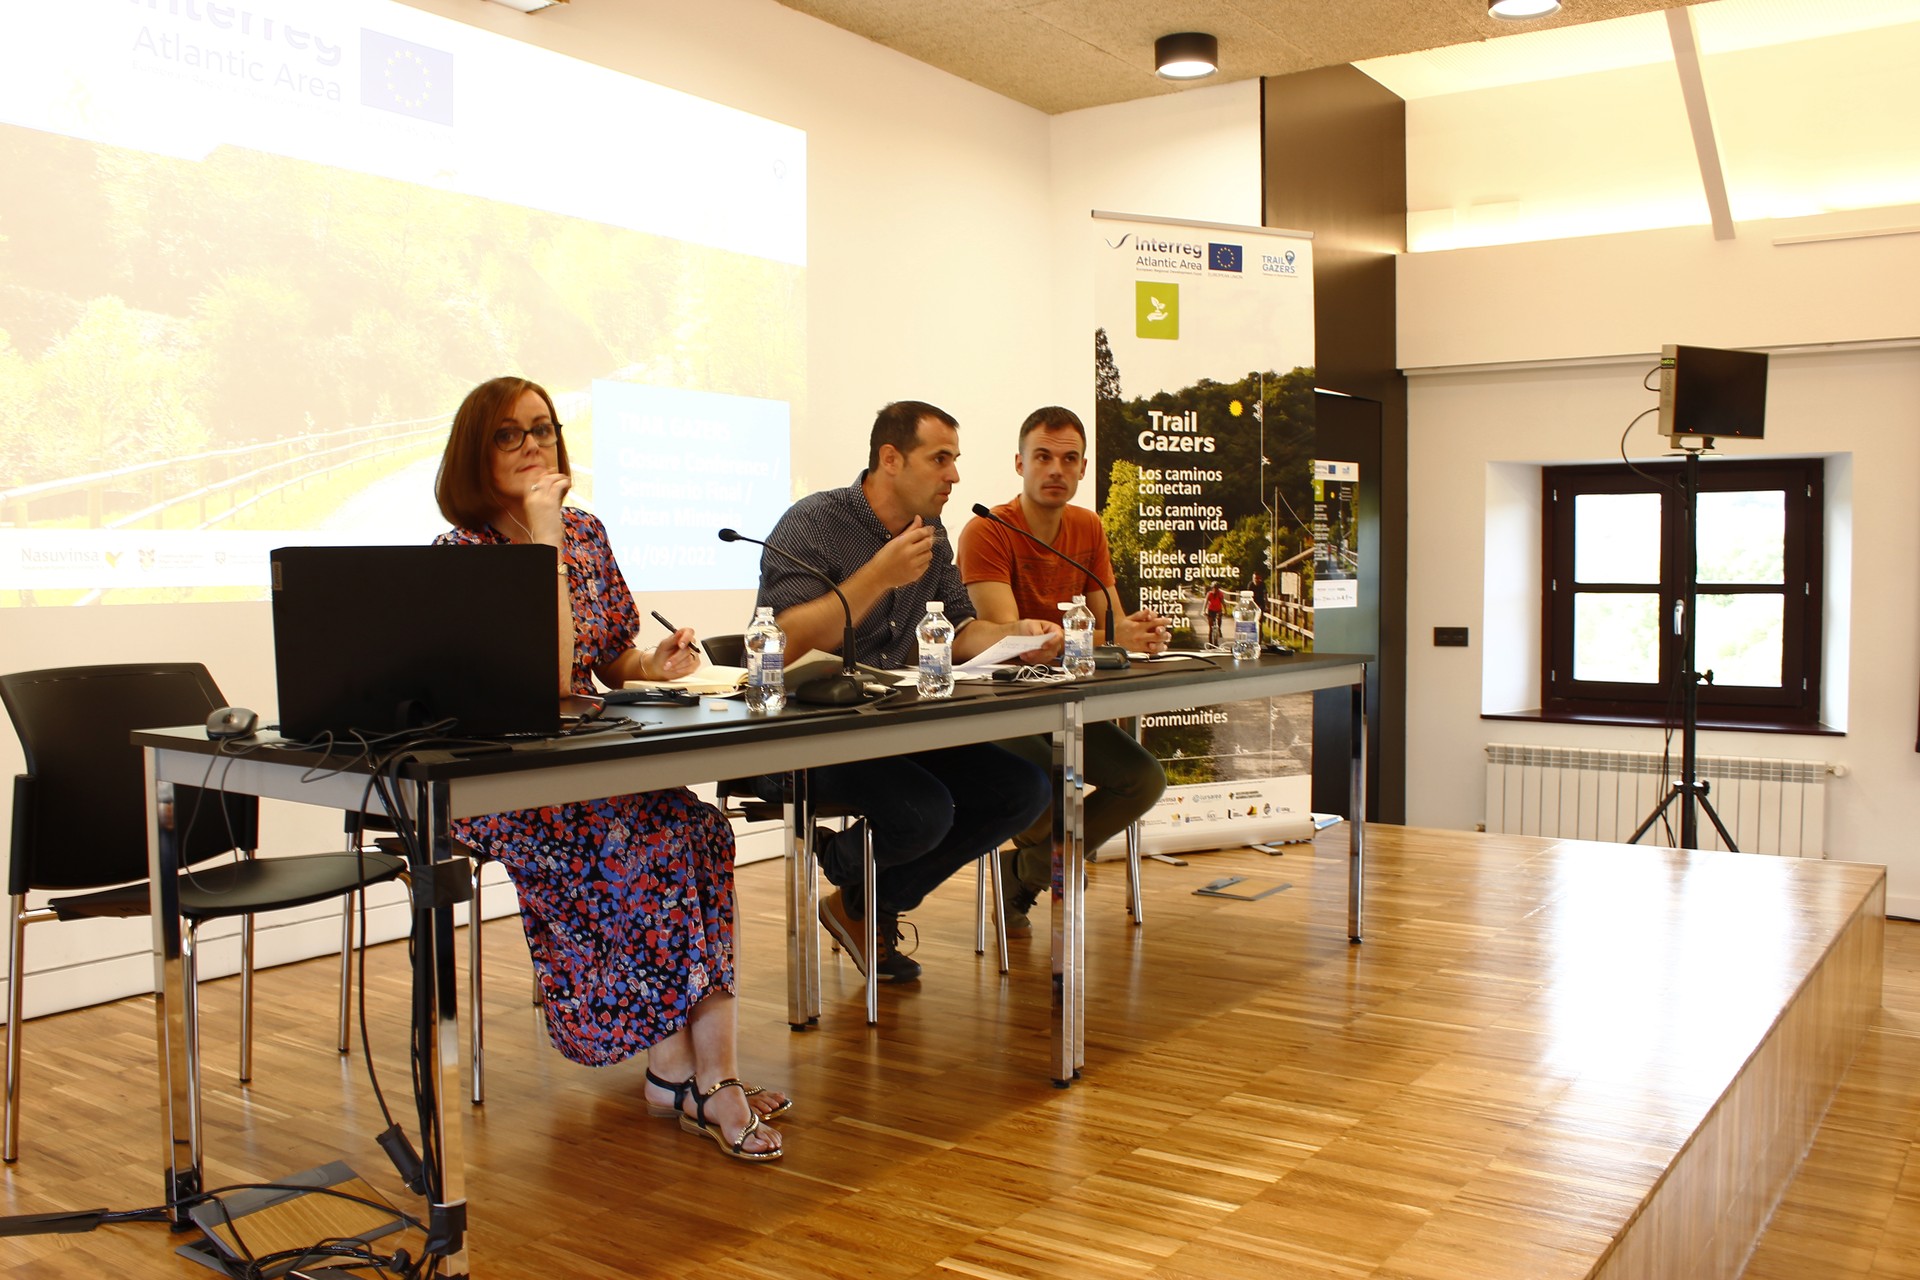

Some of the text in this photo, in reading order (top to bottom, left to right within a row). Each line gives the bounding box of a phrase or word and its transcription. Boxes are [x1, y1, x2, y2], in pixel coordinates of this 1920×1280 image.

[130, 0, 342, 67] terreg
[132, 26, 341, 103] Atlantic Area
[1135, 236, 1202, 259] Interreg
[1136, 256, 1202, 271] Atlantic Area
[1262, 255, 1285, 265] TRAIL
[1262, 264, 1295, 274] GAZERS
[1148, 410, 1198, 432] Trail
[1137, 430, 1216, 453] Gazers
[619, 448, 681, 470] Closure
[685, 453, 769, 477] Conference
[1138, 466, 1223, 482] Los caminos
[619, 478, 701, 499] Seminario
[707, 481, 742, 502] Final
[1138, 481, 1202, 495] conectan
[620, 506, 670, 526] Azken
[1139, 502, 1223, 517] Los caminos
[1138, 515, 1228, 535] generan vida
[21, 547, 100, 563] Nasuvinsa
[621, 544, 716, 570] 14/09/2022
[1139, 549, 1225, 565] Bideek elkar
[1140, 563, 1240, 582] lotzen gaituzte
[1140, 585, 1187, 600] Bideek
[1140, 709, 1229, 728] communities
